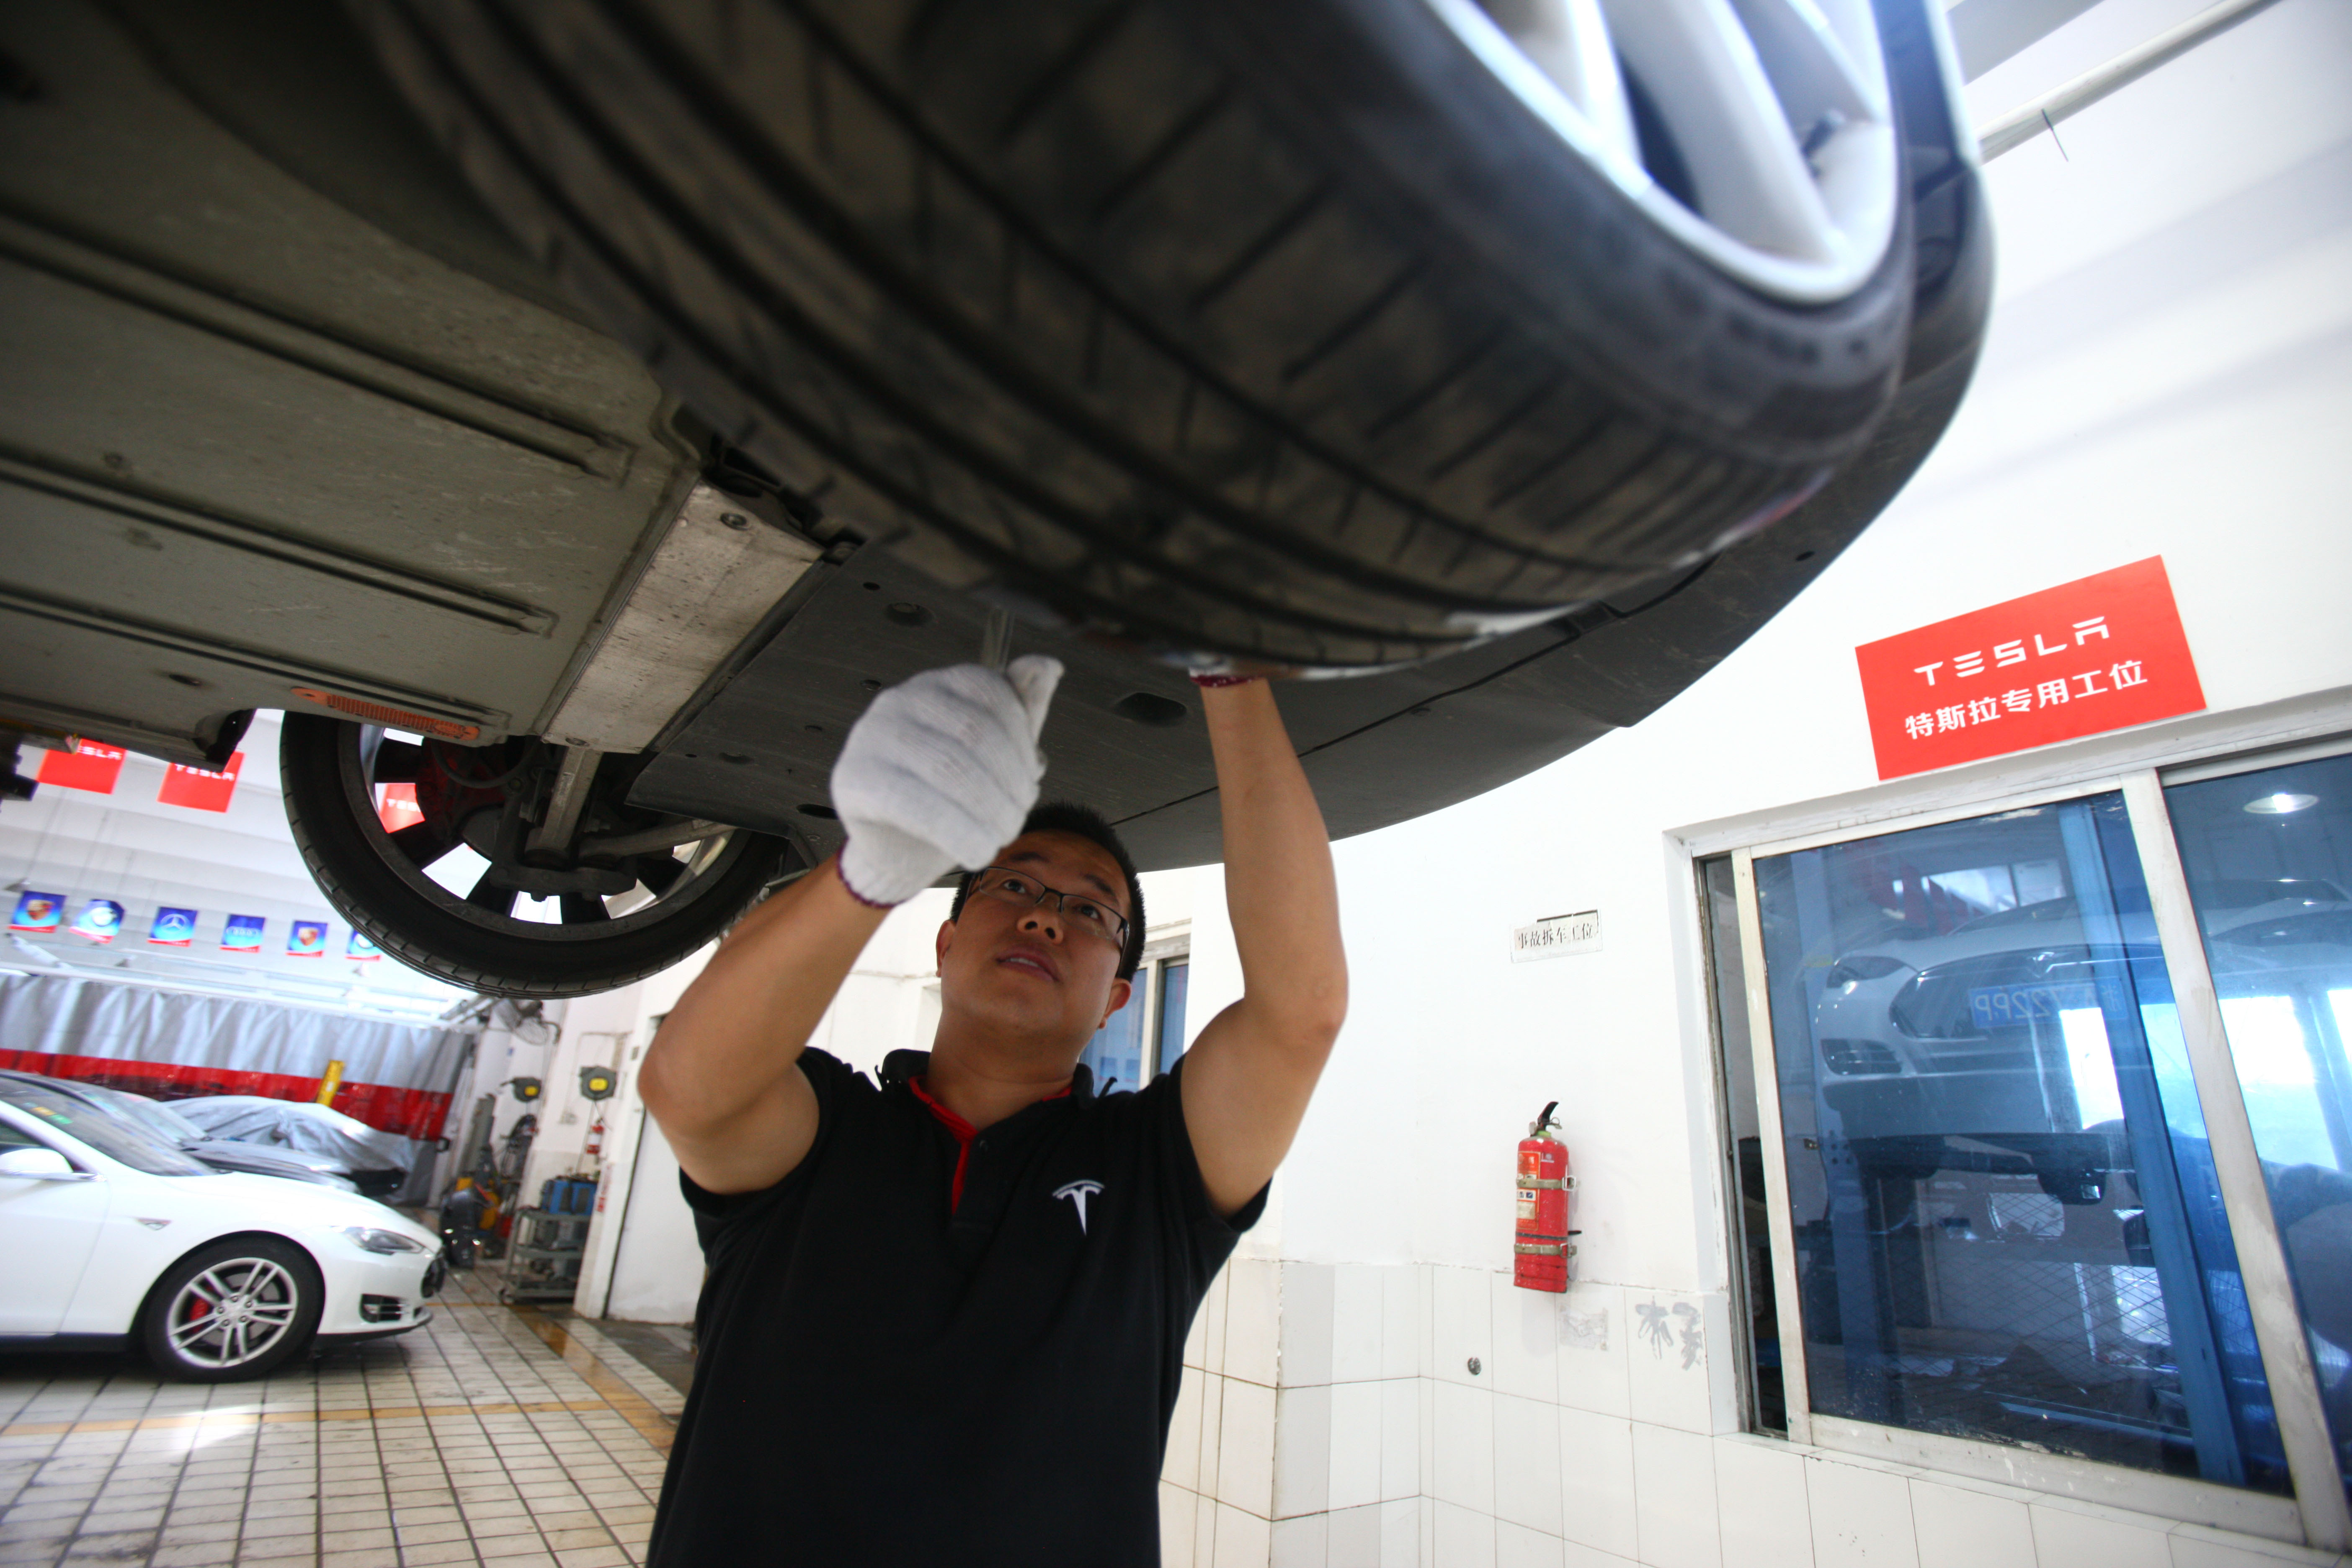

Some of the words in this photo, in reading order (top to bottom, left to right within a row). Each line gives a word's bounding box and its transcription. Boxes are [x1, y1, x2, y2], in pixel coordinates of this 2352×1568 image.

[1914, 616, 2110, 686] TESLA
[1905, 660, 2148, 740] 特斯拉专用工位
